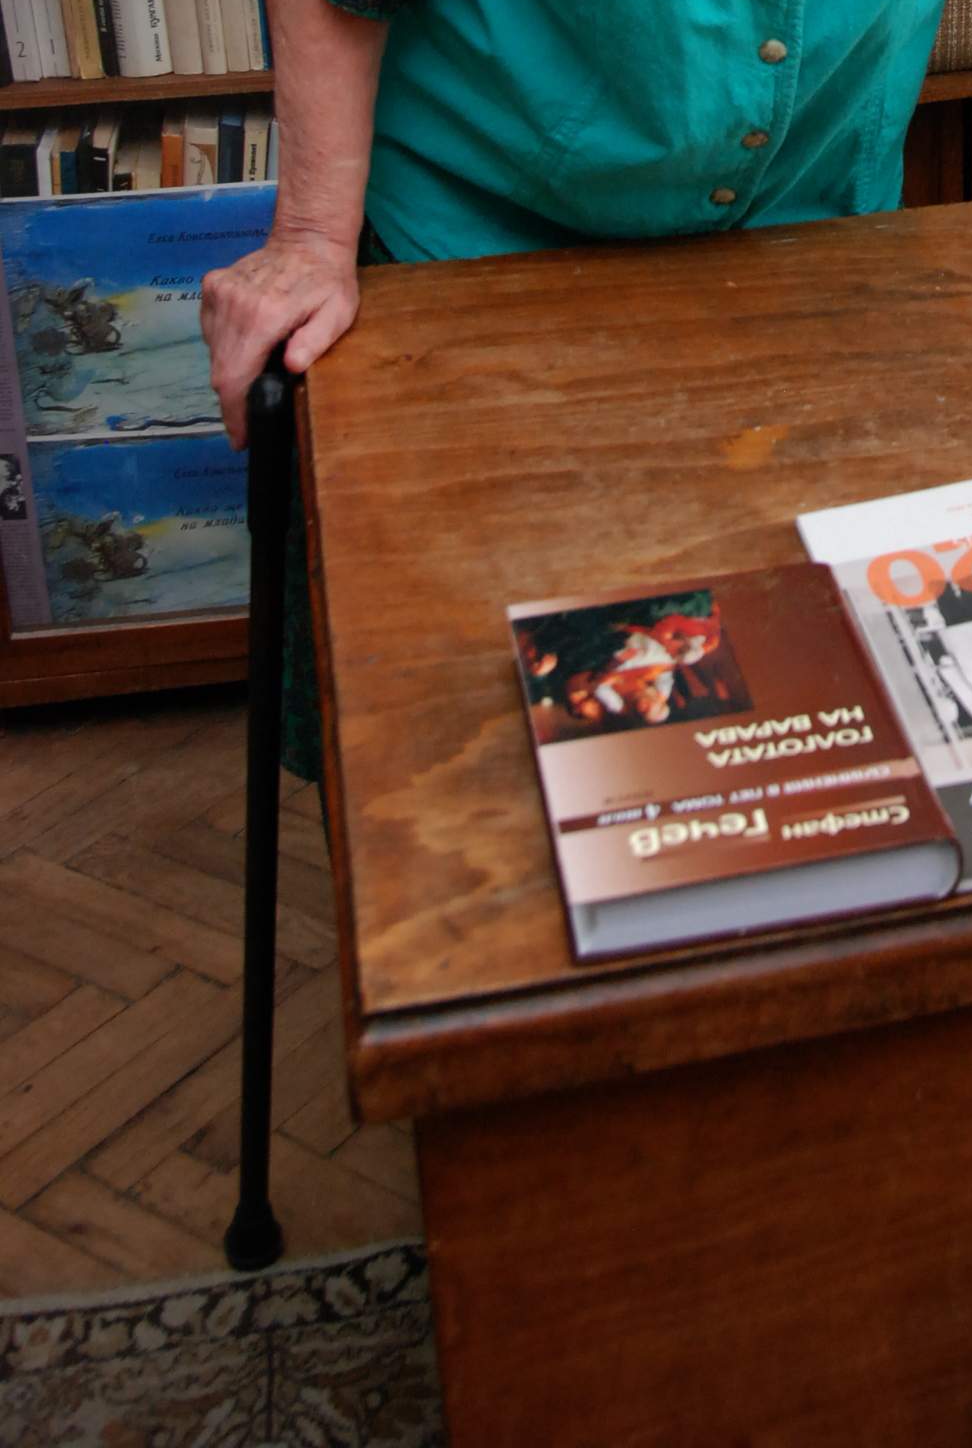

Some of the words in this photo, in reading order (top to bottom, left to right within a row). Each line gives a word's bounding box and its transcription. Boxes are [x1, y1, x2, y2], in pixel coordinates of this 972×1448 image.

[150, 273, 194, 288] Какво
[154, 293, 173, 303] на
[180, 521, 198, 532] на
[816, 704, 865, 726] НА
[693, 714, 813, 749] ВАРАВА
[705, 725, 874, 769] ГОЛГОТАТА
[766, 783, 780, 797] В
[782, 766, 891, 794] СЪЧИНЕНИЯ
[671, 793, 724, 813] ТОМА
[728, 787, 764, 805] ПЕТ
[645, 804, 661, 821] 4
[780, 804, 910, 842] Стефан
[627, 808, 769, 859] Гечев
